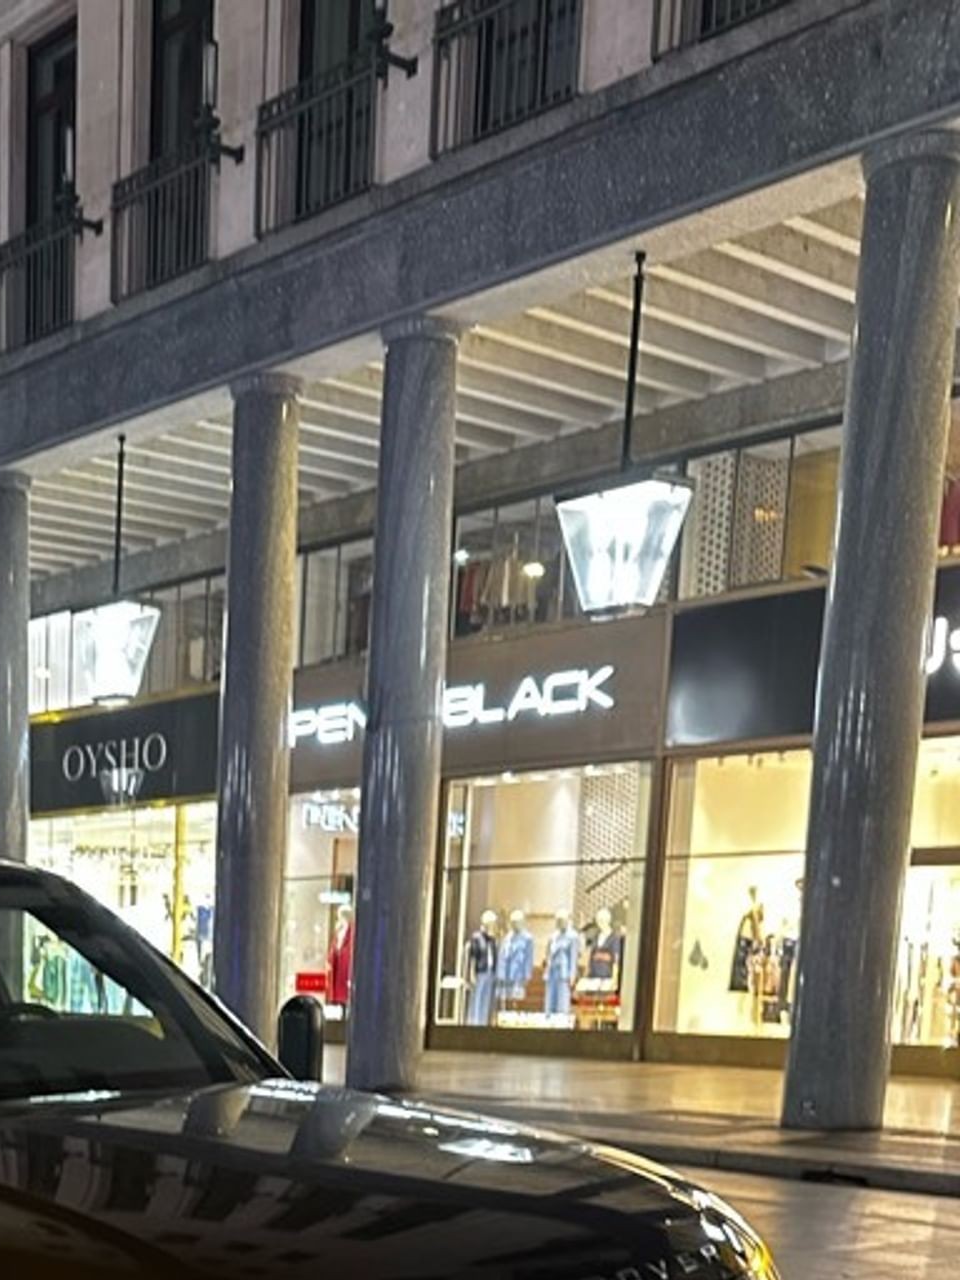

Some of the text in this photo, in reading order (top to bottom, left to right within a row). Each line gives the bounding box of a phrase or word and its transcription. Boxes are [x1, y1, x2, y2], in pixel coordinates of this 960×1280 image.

[288, 664, 615, 749] PEN BLACK
[62, 733, 167, 782] OYSHO
